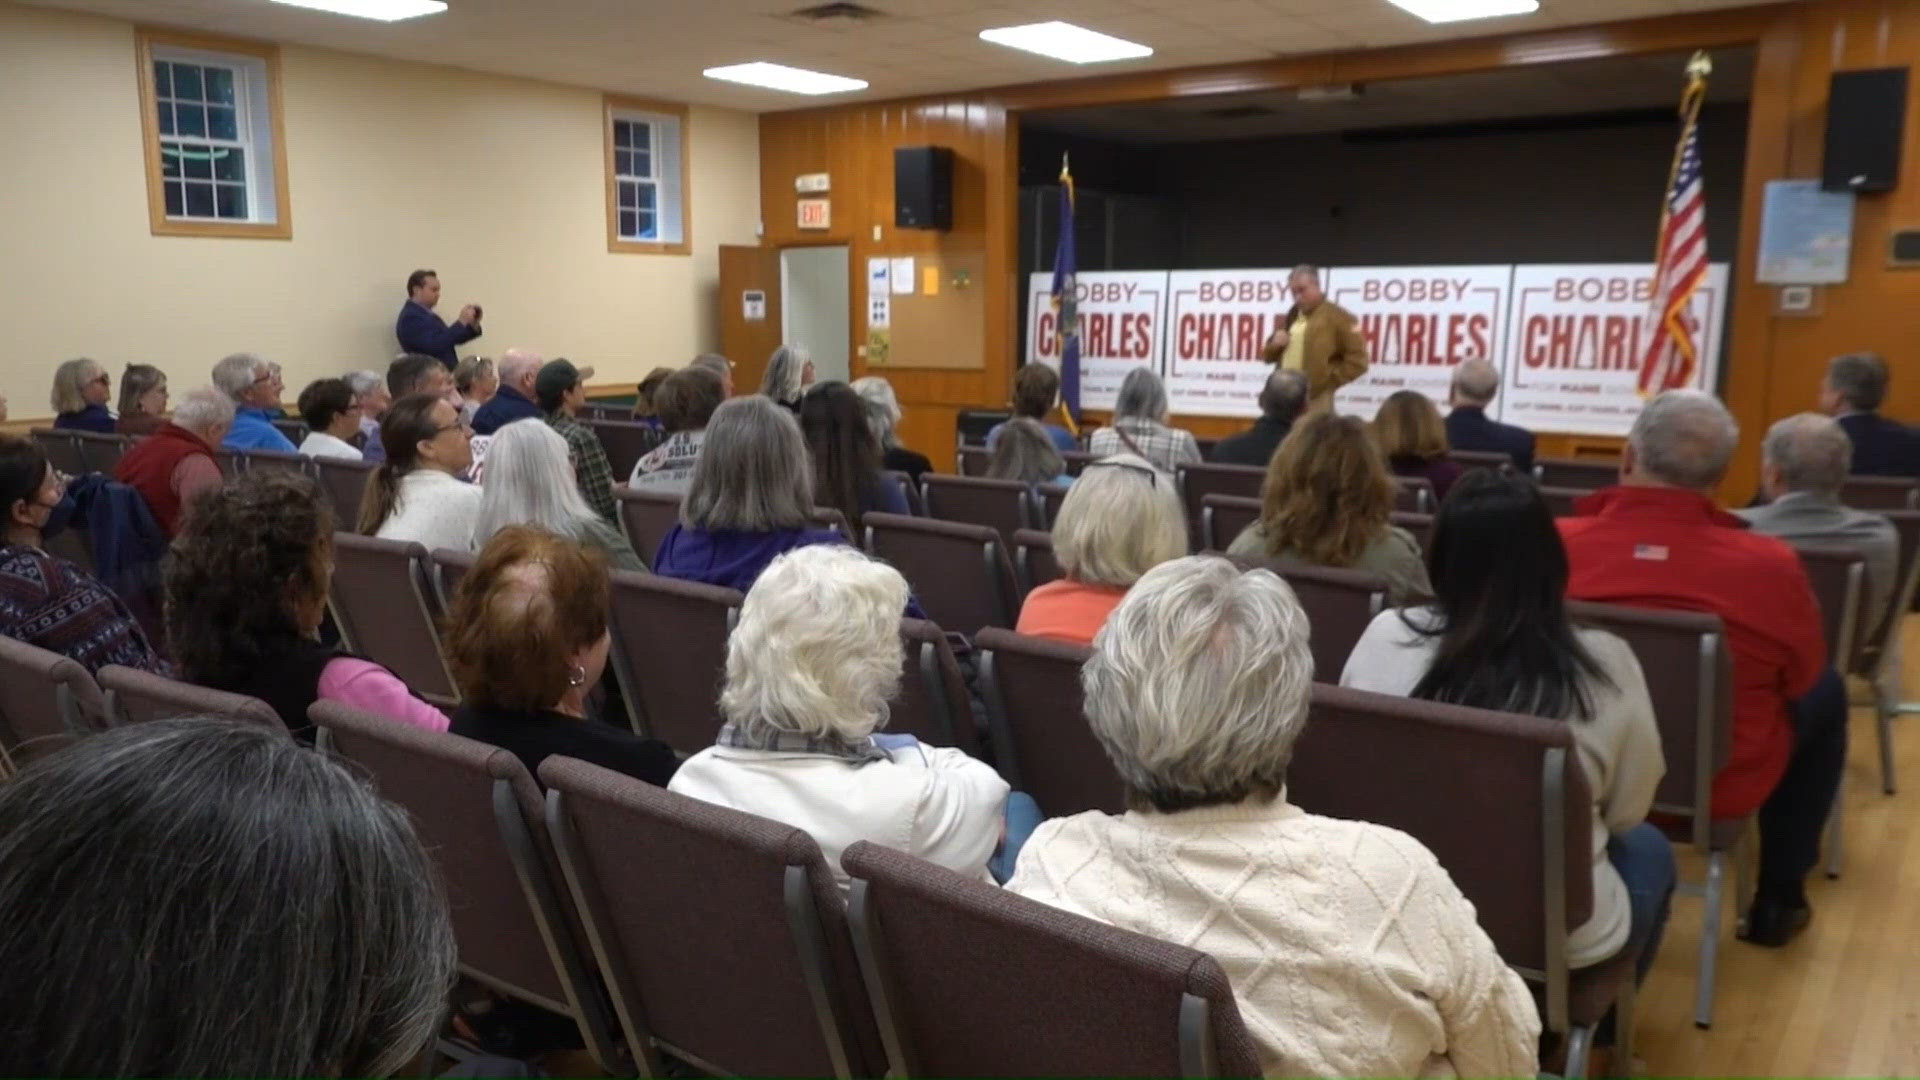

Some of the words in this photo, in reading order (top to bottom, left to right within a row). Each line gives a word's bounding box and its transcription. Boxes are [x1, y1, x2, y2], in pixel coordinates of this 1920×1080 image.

[1075, 282, 1138, 302] OBBY
[1199, 281, 1290, 302] BOBBY
[1363, 279, 1471, 302] BOBBY
[1555, 278, 1655, 302] BOBB
[1039, 312, 1151, 358] CARLES
[1179, 313, 1287, 361] CHARL
[1361, 314, 1489, 365] HARLES
[1524, 314, 1643, 371] CHARL
